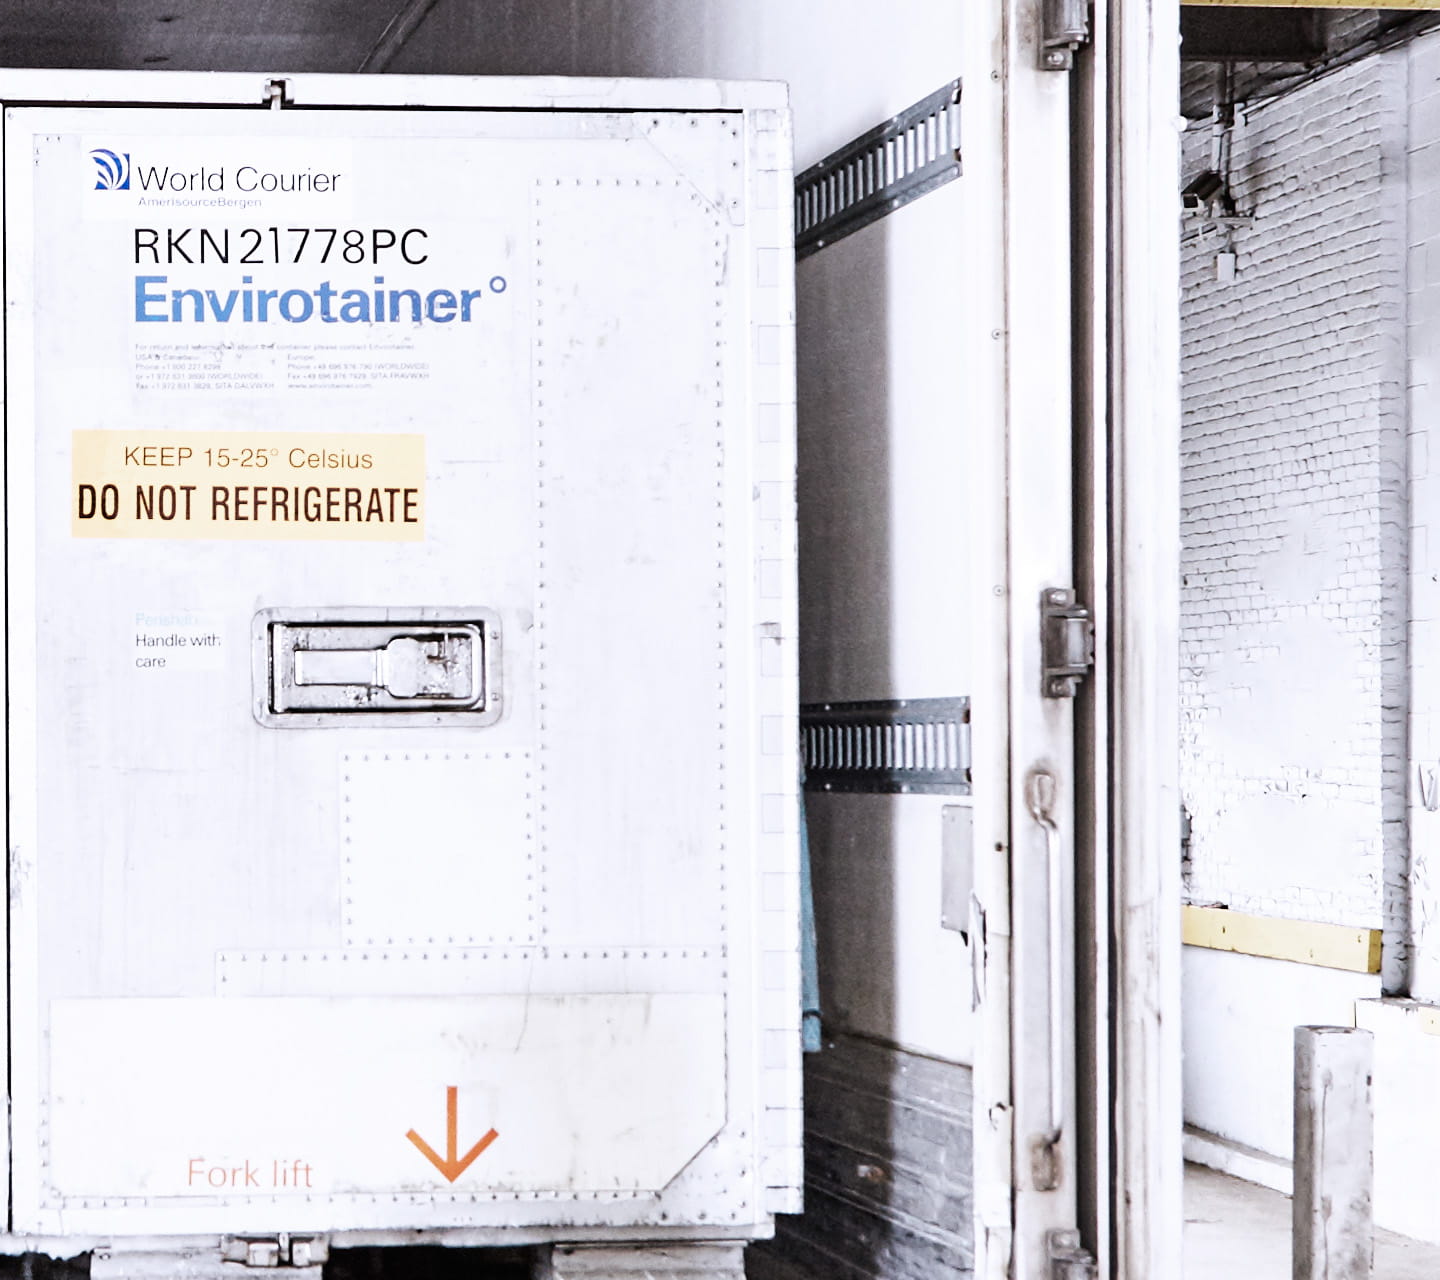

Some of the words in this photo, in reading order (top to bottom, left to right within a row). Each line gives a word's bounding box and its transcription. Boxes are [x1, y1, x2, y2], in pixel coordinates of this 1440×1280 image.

[137, 165, 225, 193] World
[235, 165, 342, 193] Courier
[124, 446, 193, 469] KEEP
[203, 446, 281, 470] 15-25°
[288, 446, 374, 471] Celsius
[78, 484, 120, 523] DO
[136, 484, 196, 523] NOT
[211, 486, 419, 525] REFRIGERATE
[135, 632, 187, 648] Handle
[190, 632, 223, 648] with
[134, 656, 167, 669] care
[188, 1159, 261, 1188] Fork
[271, 1158, 314, 1188] lift
